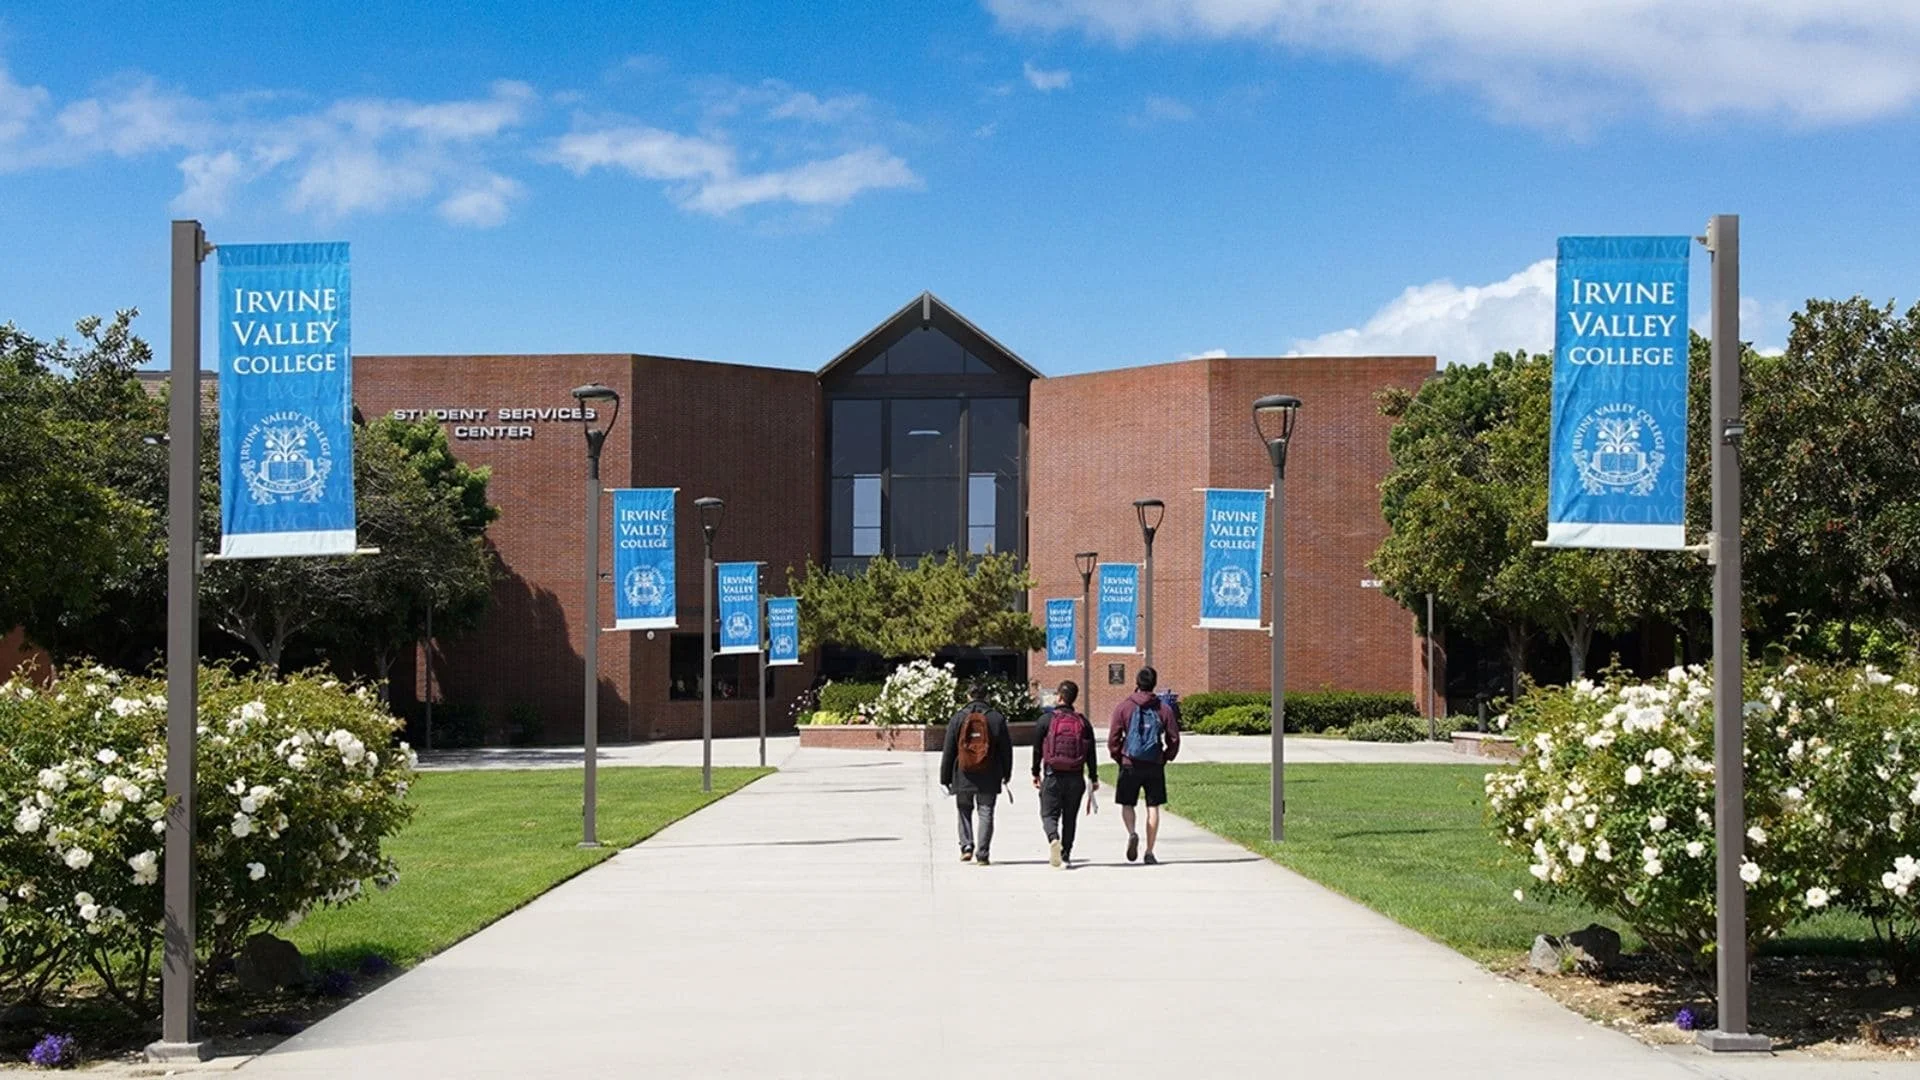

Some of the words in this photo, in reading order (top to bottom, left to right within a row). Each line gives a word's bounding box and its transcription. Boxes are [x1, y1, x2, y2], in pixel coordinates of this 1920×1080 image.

[1572, 279, 1675, 305] IRVINE
[234, 288, 336, 314] IRVINE
[1568, 311, 1676, 337] VALLEY
[232, 321, 338, 346] VALLEY
[1568, 346, 1674, 366] COLLEGE
[233, 353, 336, 375] COLLEGE
[498, 407, 596, 420] SERVICES
[455, 426, 533, 438] CENTER
[1572, 414, 1596, 450] IRVINE
[1595, 403, 1636, 417] VALLEY
[1636, 409, 1665, 450] COLLEGE
[240, 424, 262, 461] IRVINE
[261, 411, 302, 426] VALLEY
[302, 415, 332, 456] COLLEGE
[621, 509, 668, 521] IRVINE
[1212, 509, 1258, 522] IRVINE
[620, 523, 668, 536] VALLEY
[1210, 523, 1258, 537] VALLEY
[620, 539, 668, 549] COLLEGE
[1209, 539, 1257, 549] COLLEGE
[1102, 586, 1134, 594] VALLEY
